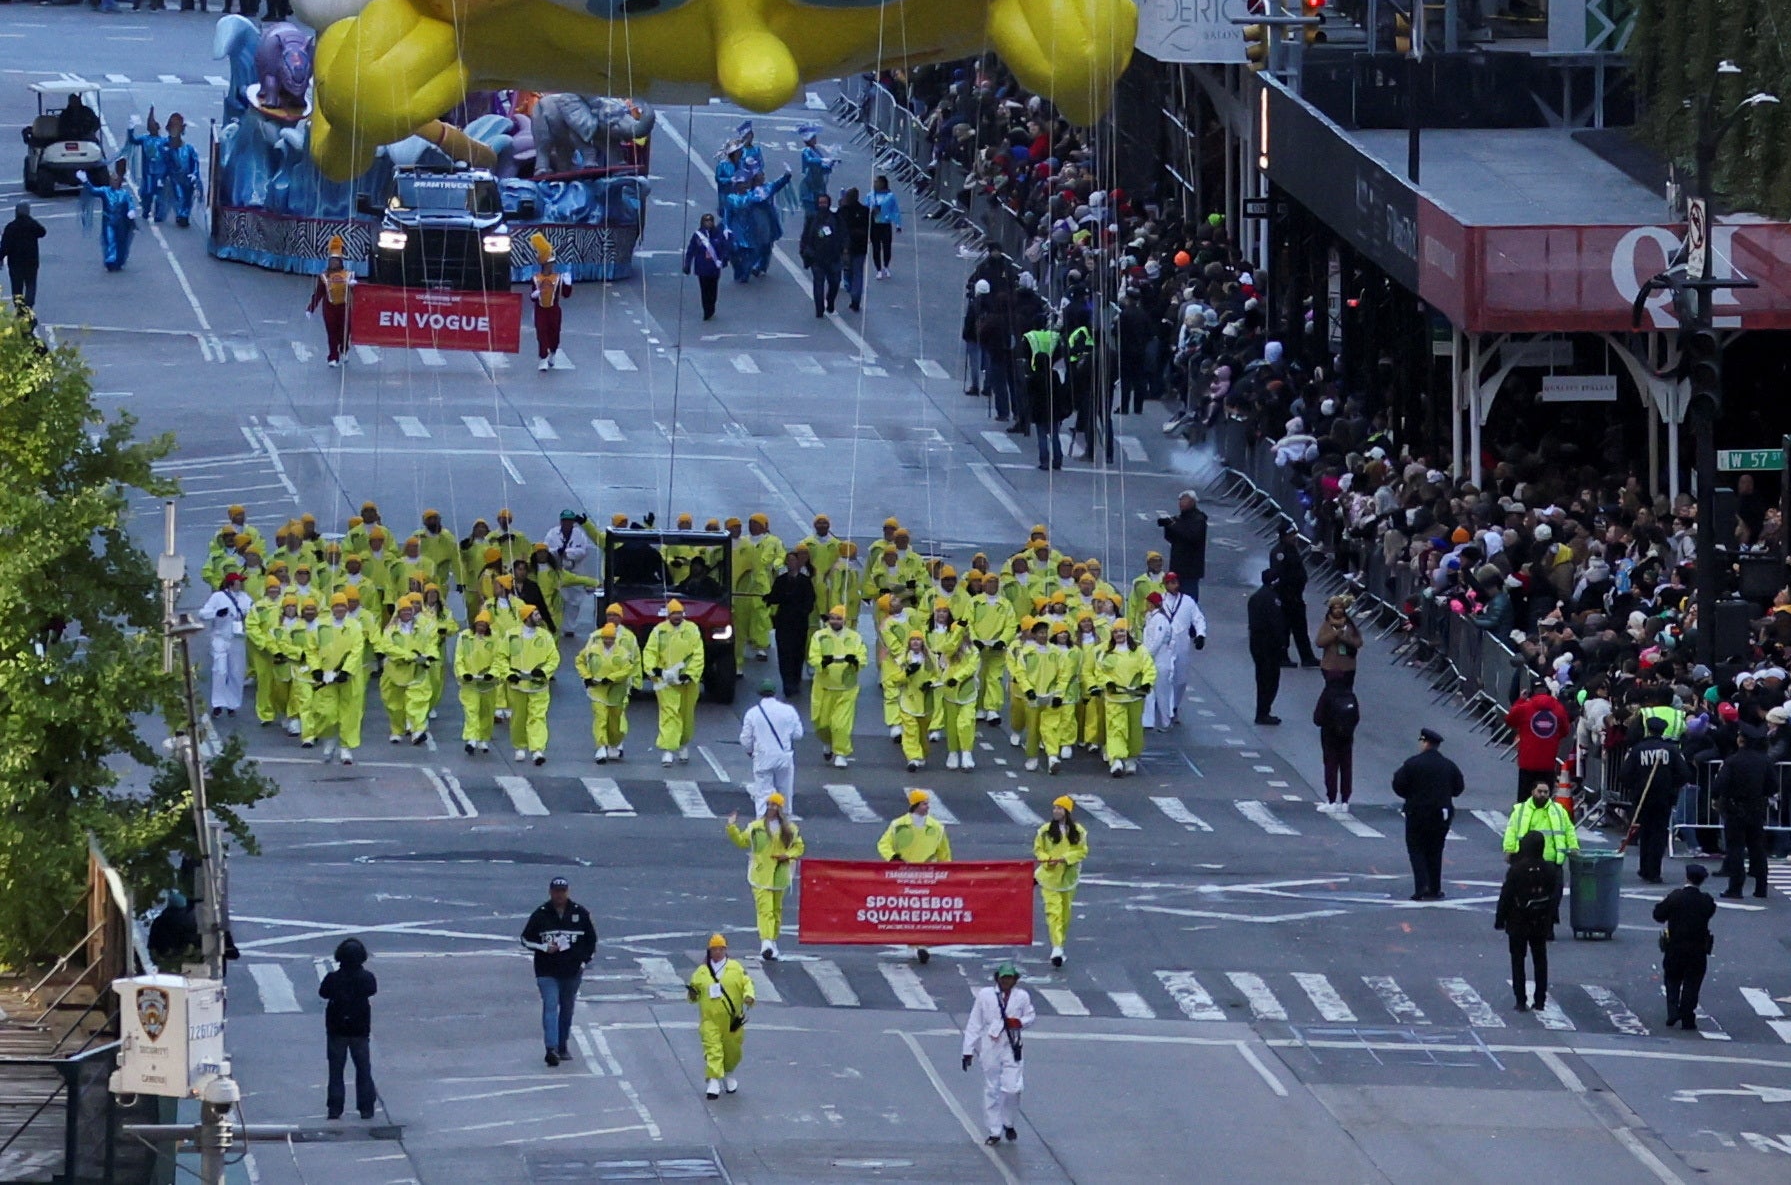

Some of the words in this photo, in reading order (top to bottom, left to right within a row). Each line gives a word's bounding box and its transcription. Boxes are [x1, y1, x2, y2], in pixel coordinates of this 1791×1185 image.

[379, 311, 408, 327] EN
[415, 312, 490, 332] VOGUE
[1731, 453, 1742, 468] W
[1751, 452, 1768, 468] 57
[866, 895, 964, 909] SPONGEBOB
[857, 909, 973, 923] SQUAREPANTS
